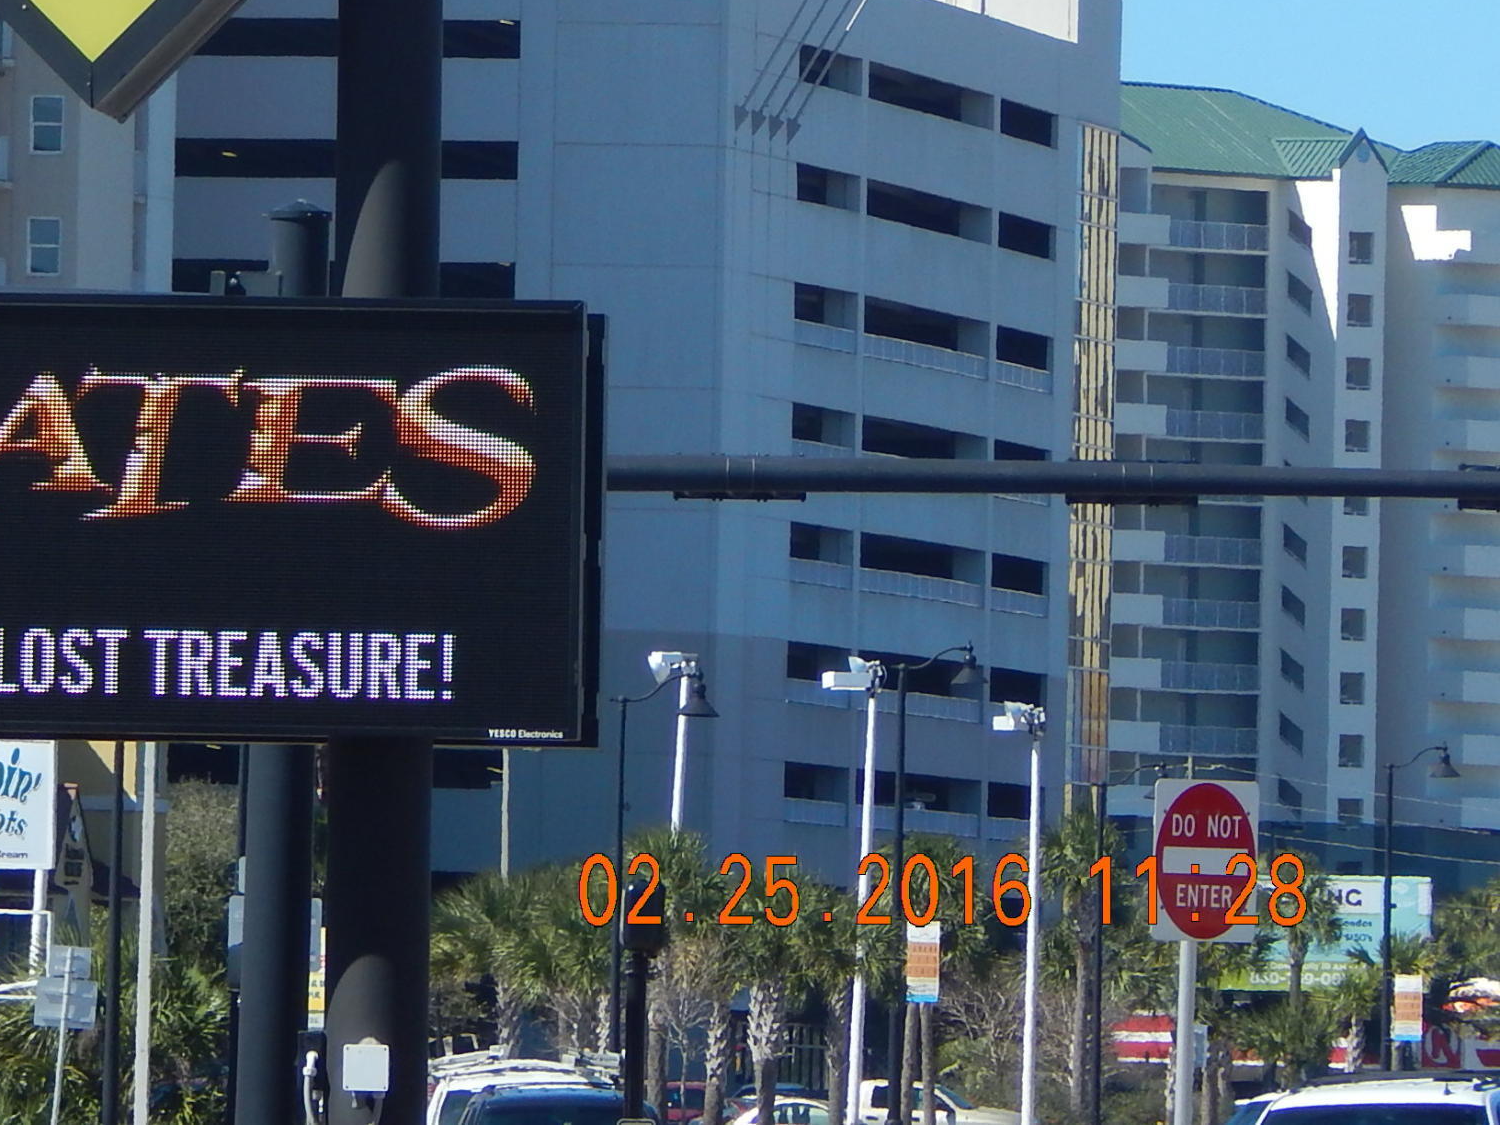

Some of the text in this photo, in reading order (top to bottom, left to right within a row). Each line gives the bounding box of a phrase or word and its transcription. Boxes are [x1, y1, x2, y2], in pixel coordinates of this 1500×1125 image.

[142, 630, 456, 701] TREASURE!
[488, 728, 564, 739] YESCO Electronics
[1171, 813, 1242, 839] DO NOT
[1175, 883, 1233, 909] ENTER
